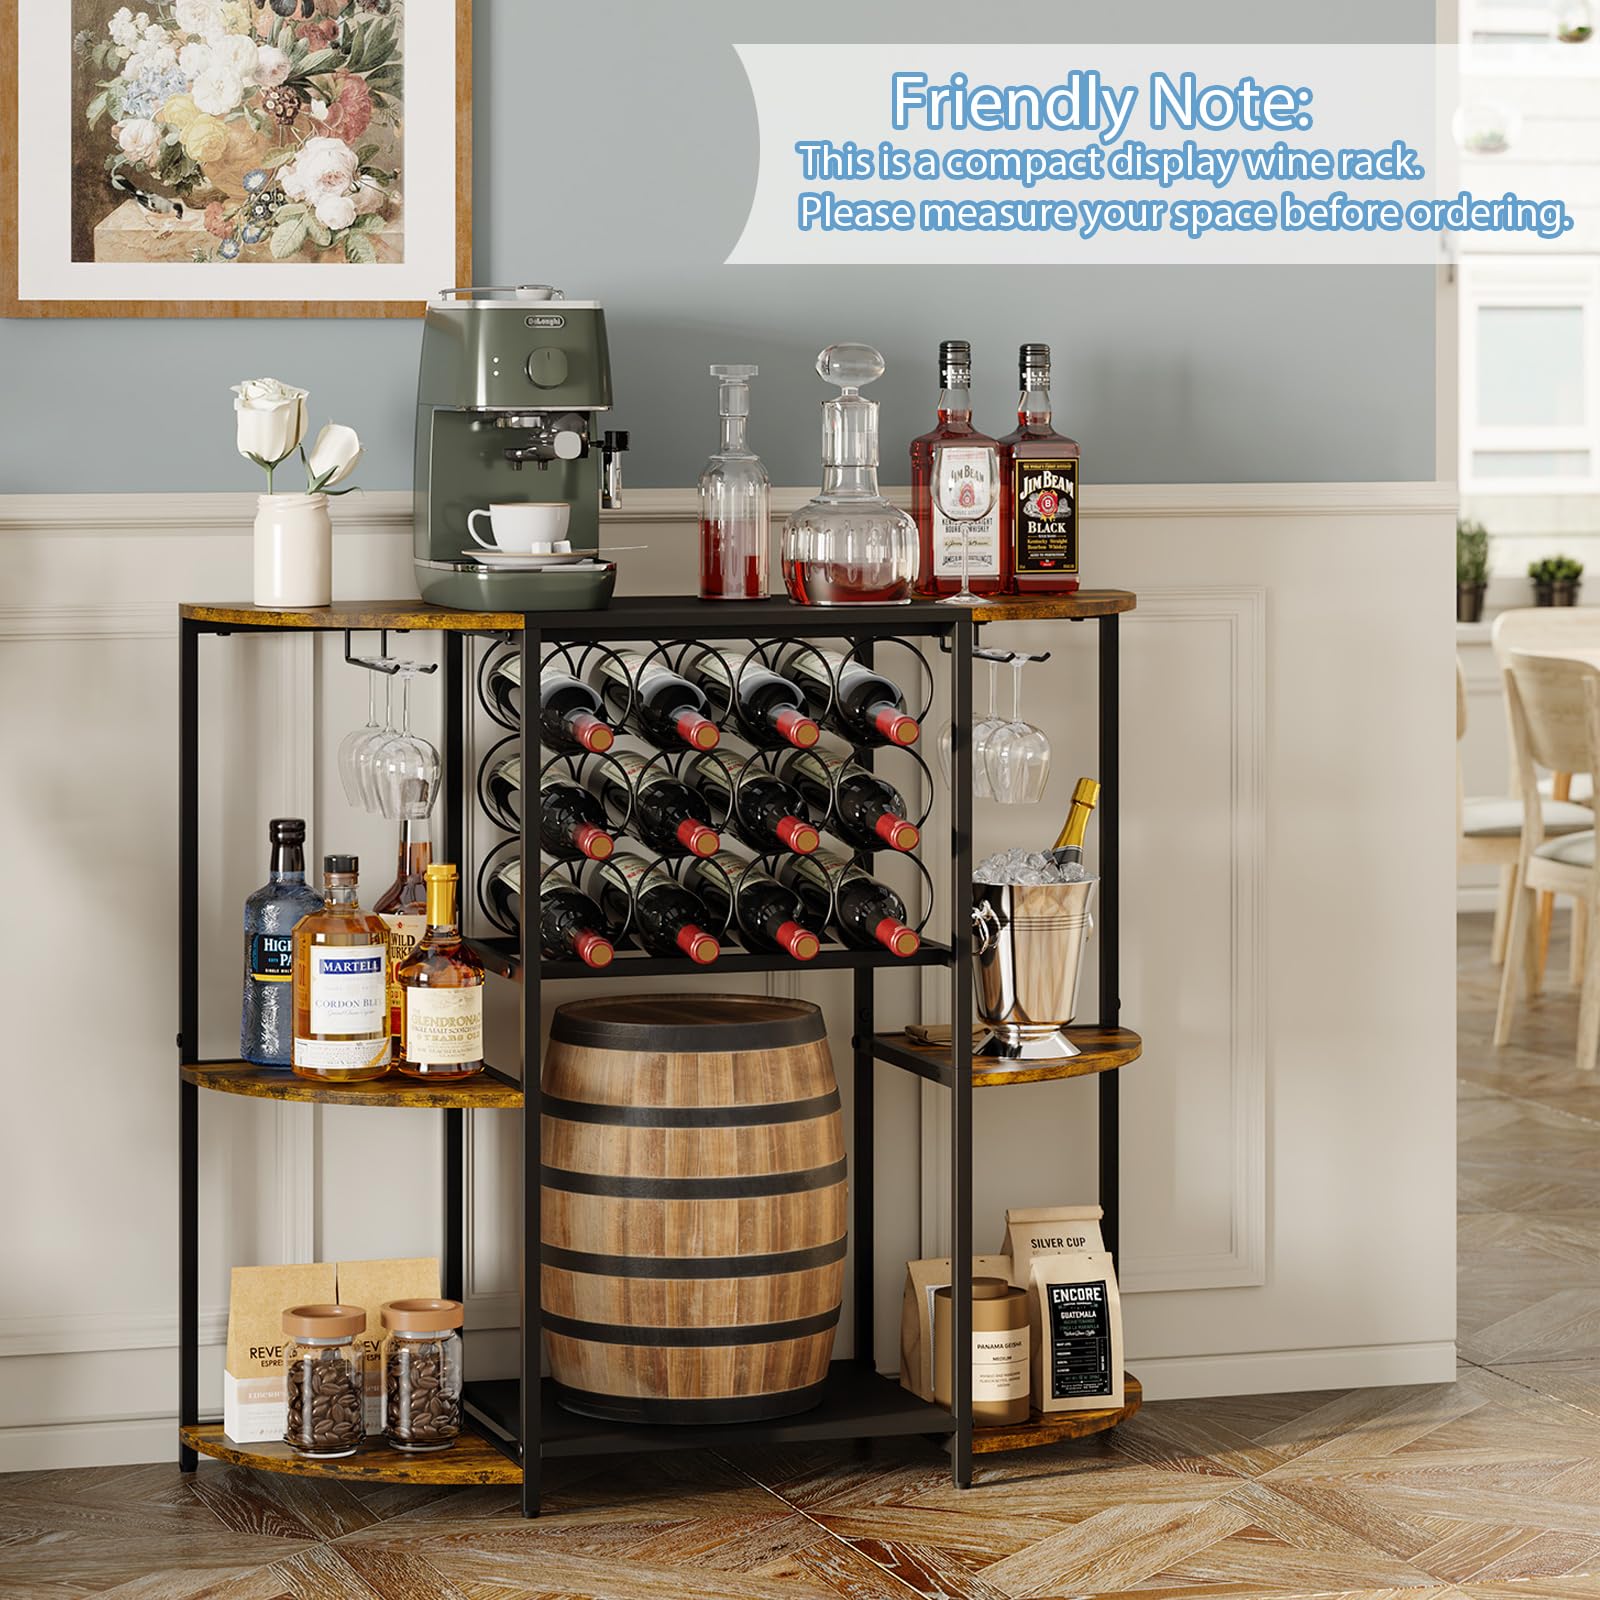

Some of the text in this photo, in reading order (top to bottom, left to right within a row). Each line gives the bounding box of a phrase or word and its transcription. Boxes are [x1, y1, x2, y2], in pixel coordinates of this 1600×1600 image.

[1020, 470, 1074, 500] JIM BEAM
[1027, 521, 1067, 534] BLACK
[391, 933, 415, 946] WILD
[323, 960, 379, 972] MARTELL
[315, 1000, 360, 1009] CORDON
[1030, 1237, 1086, 1249] SILVER CUP
[1053, 1287, 1102, 1303] ENCORE
